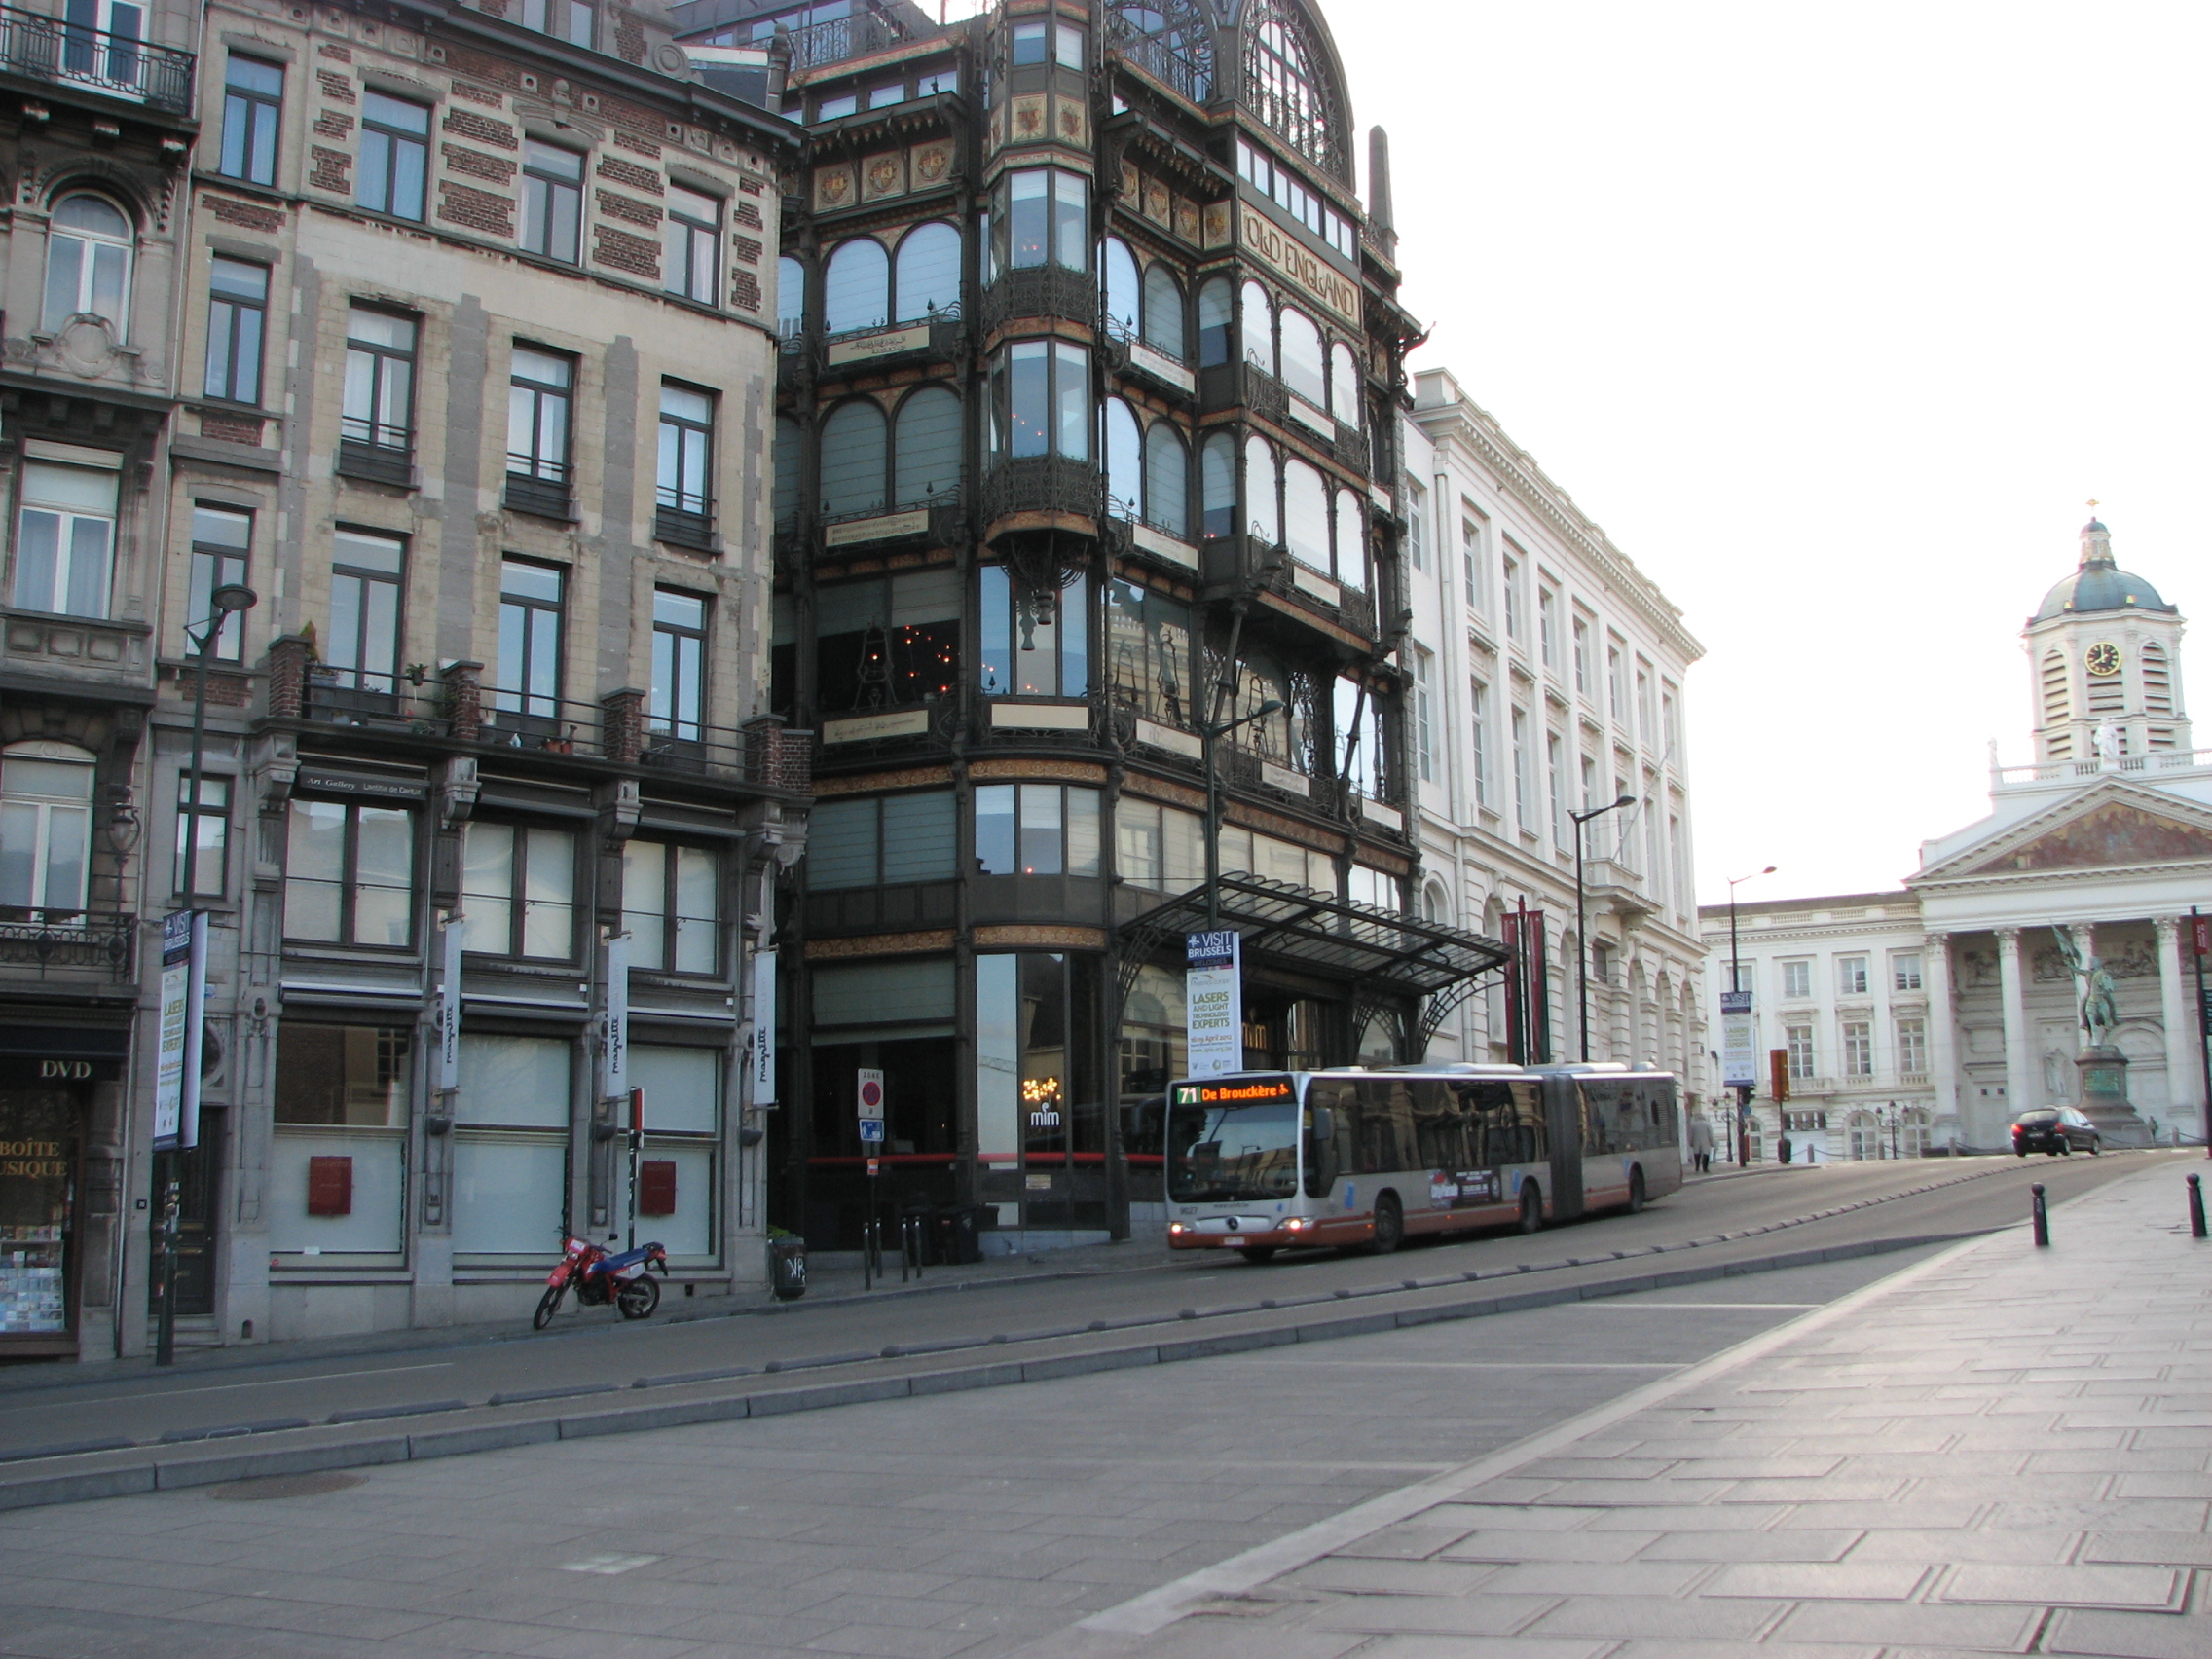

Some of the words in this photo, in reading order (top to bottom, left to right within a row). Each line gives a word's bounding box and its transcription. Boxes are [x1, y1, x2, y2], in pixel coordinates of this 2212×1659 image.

[1247, 216, 1281, 263] OLD
[1285, 240, 1354, 316] ENGLAND
[325, 779, 355, 791] Gallery
[1201, 931, 1232, 947] VISIT
[1188, 945, 1232, 958] BRUSSELS
[1193, 992, 1229, 1004] LASERS
[1208, 1002, 1229, 1011] LIGHT
[1193, 1017, 1230, 1029] EXPERTS
[41, 1060, 92, 1079] DVD
[1179, 1088, 1197, 1103] 71
[1201, 1088, 1217, 1101] De
[1219, 1085, 1276, 1100] Brouckère
[1030, 1102, 1059, 1125] mim
